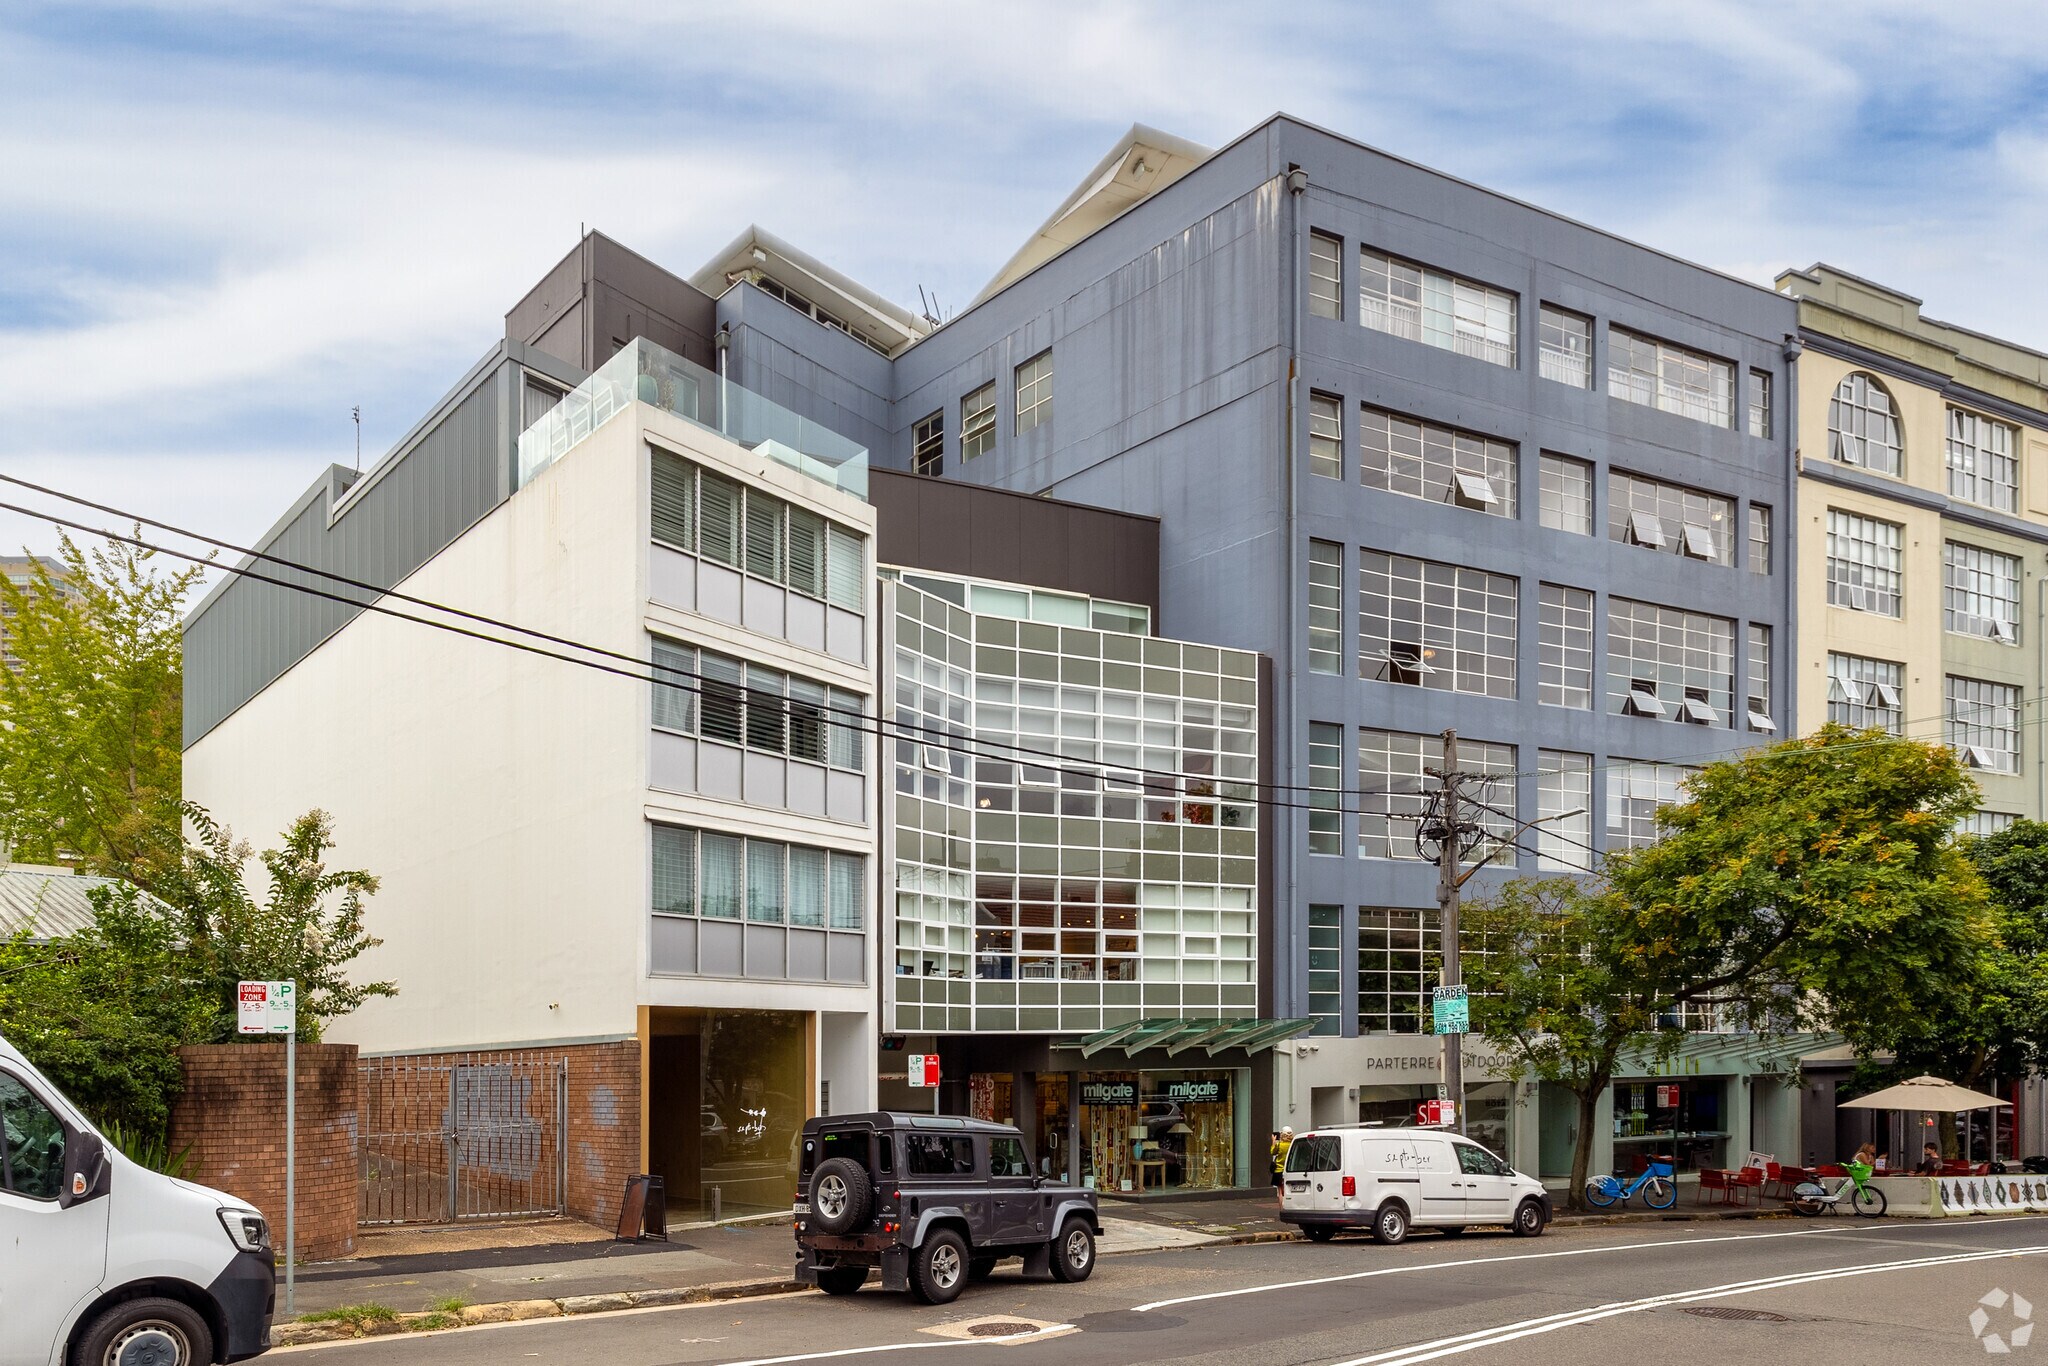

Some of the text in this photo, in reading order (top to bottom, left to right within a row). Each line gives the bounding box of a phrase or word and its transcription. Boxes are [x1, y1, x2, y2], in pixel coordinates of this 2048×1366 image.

[240, 985, 266, 993] LOADING
[1433, 988, 1468, 999] GARDEN
[243, 993, 263, 1001] ZONE
[1367, 1056, 1435, 1070] PARTERRE
[1083, 1083, 1134, 1100] milgate
[1169, 1081, 1218, 1099] milgate
